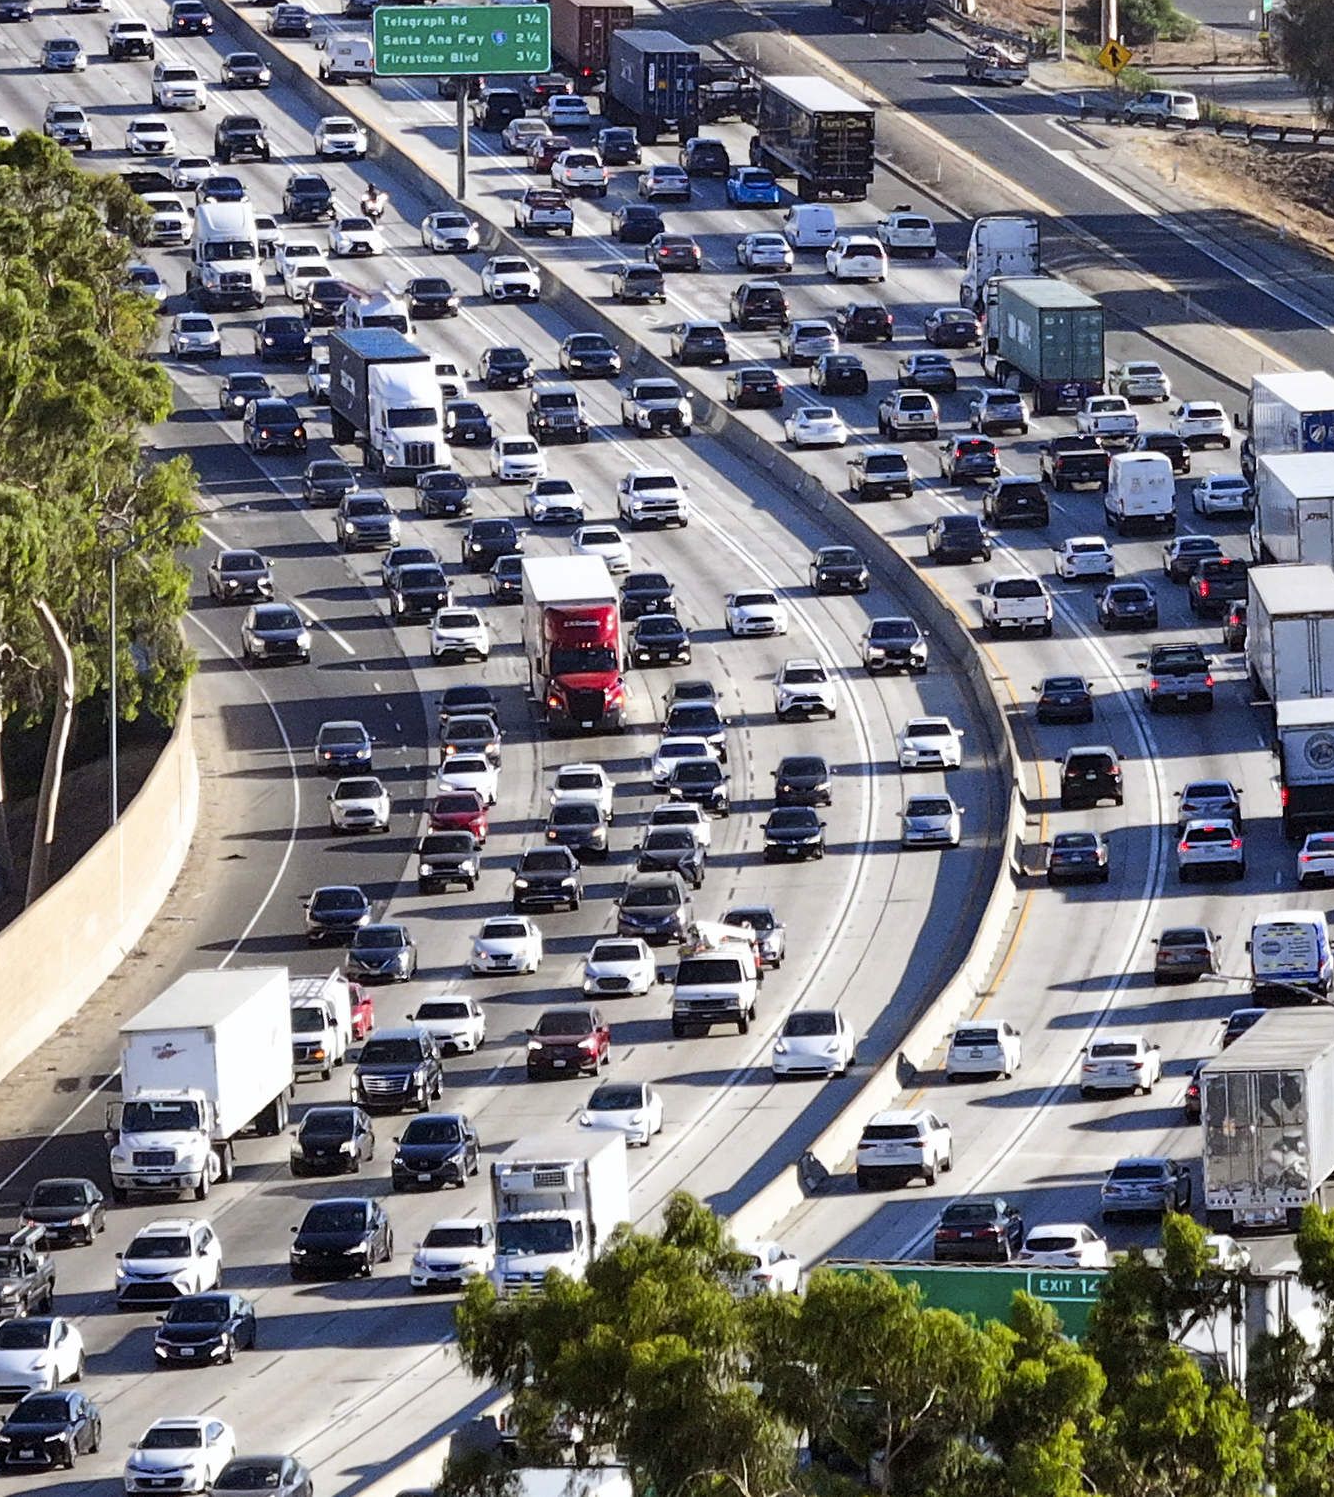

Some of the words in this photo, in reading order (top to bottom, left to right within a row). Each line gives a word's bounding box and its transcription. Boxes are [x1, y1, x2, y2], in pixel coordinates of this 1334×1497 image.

[383, 15, 445, 29] Telegraph
[451, 14, 467, 26] Rd
[383, 34, 421, 46] Santa
[427, 34, 452, 45] Ana
[458, 33, 485, 47] Fwy
[383, 53, 445, 64] Firestone
[450, 52, 479, 63] Blvd
[1039, 1279, 1072, 1292] EXIT
